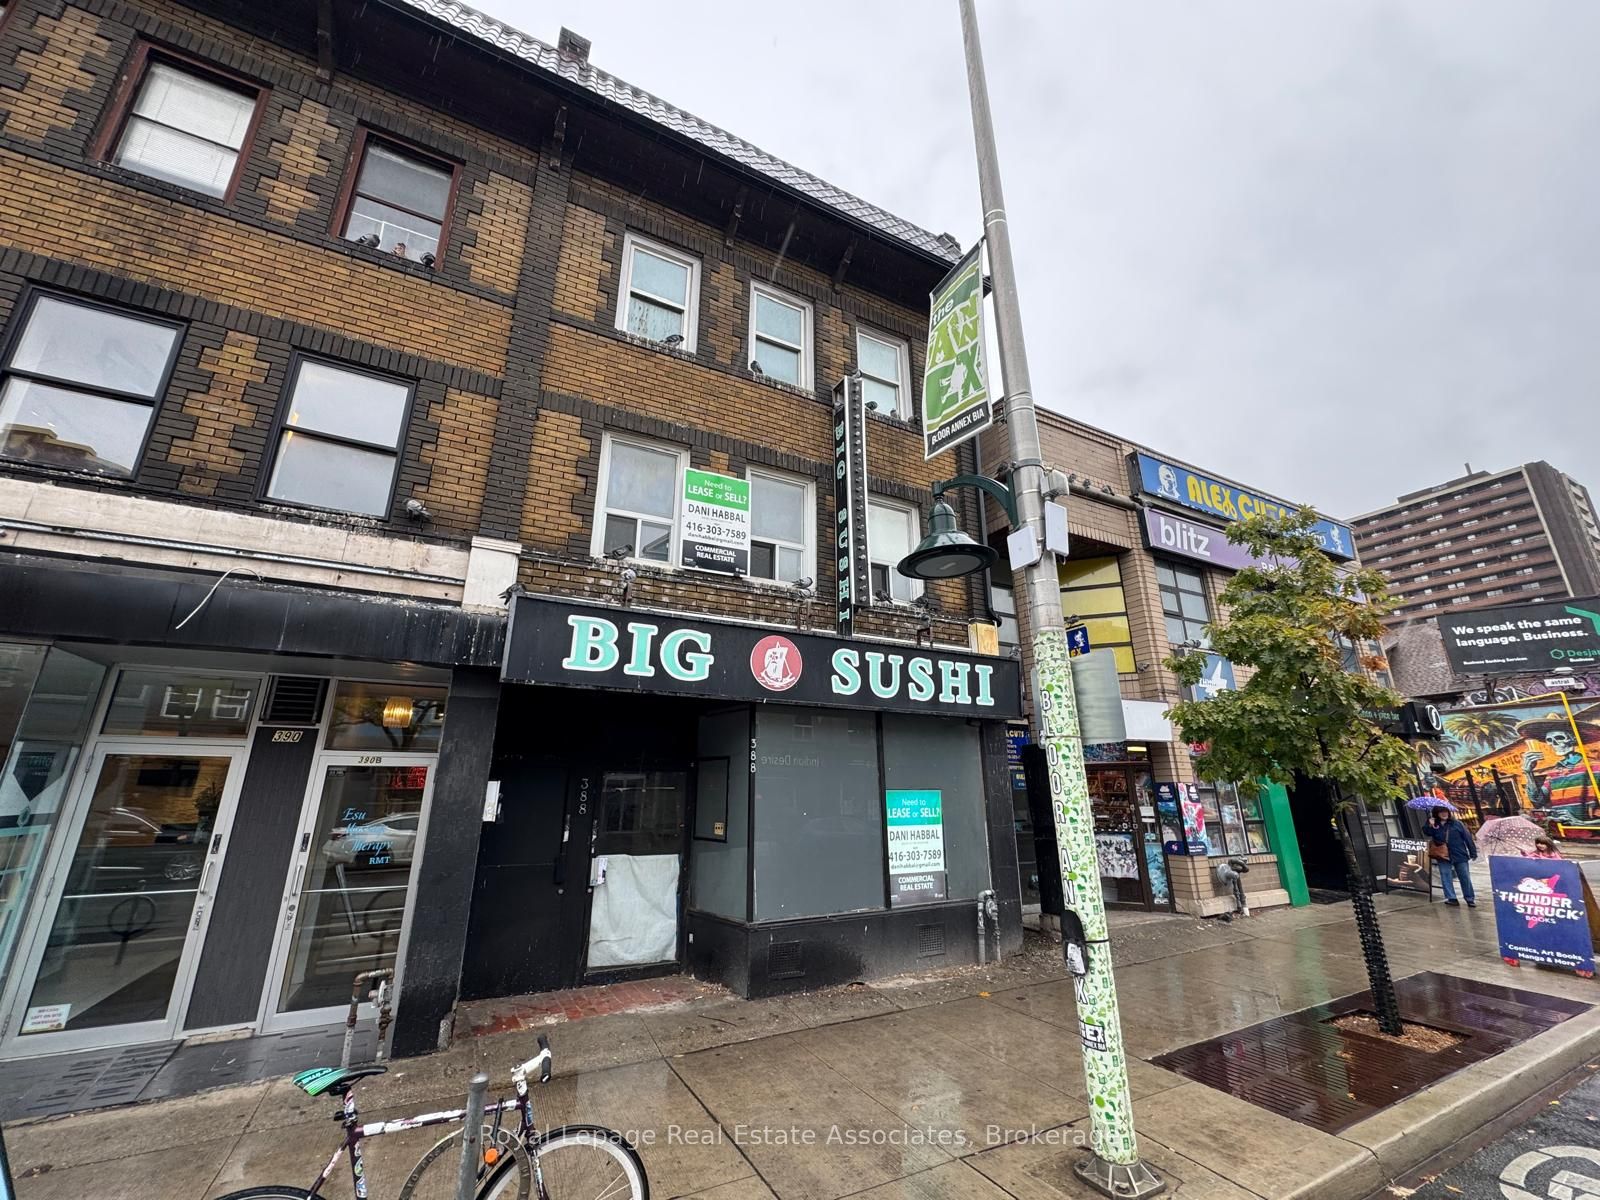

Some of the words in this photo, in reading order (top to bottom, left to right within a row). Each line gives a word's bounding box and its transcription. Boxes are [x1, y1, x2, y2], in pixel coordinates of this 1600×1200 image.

[933, 299, 954, 325] the
[932, 426, 950, 445] BLOOR
[951, 414, 972, 433] ANNEX
[972, 408, 984, 421] BIA
[835, 420, 846, 480] BIG
[704, 480, 723, 489] Need
[724, 483, 732, 491] to
[687, 484, 714, 498] LEASE
[715, 492, 723, 500] or
[724, 491, 747, 504] SELL?
[688, 503, 710, 516] DANI
[712, 510, 746, 523] HABBAL
[686, 521, 746, 540] 416-303-7589
[1159, 516, 1210, 556] blitz
[695, 544, 736, 557] COMMERCIAL
[696, 551, 712, 560] REAL
[713, 554, 735, 563] ESTATE
[837, 507, 850, 623] SUSHI
[1452, 626, 1474, 635] We
[1477, 622, 1516, 634] speak
[1517, 620, 1542, 629] the
[1544, 617, 1582, 627] same
[1456, 636, 1521, 647] language.
[1523, 630, 1588, 641] Business.
[562, 614, 714, 681] BIG
[831, 647, 995, 706] SUSHI
[272, 730, 302, 742] 390
[358, 756, 382, 764] 390B
[1040, 689, 1066, 824] BLOOR
[579, 778, 589, 815] 388
[342, 808, 367, 820] Esu
[888, 808, 910, 818] LEASE
[920, 808, 940, 817] SELL?
[889, 831, 909, 841] DANI
[910, 829, 940, 840] HABBAL
[1390, 839, 1427, 847] CHOCOLATE
[1391, 843, 1427, 851] THERAPY
[889, 849, 941, 862] 416-303-7589
[898, 874, 935, 884] COMMERCIAL
[914, 882, 934, 890] ESTATE
[1500, 891, 1572, 908] THUNDER
[1516, 904, 1580, 920] STRUCK
[1525, 915, 1556, 924] BOOKS
[1508, 944, 1539, 955] Comics,
[1556, 952, 1585, 961] Books,
[1518, 953, 1545, 962] Manga
